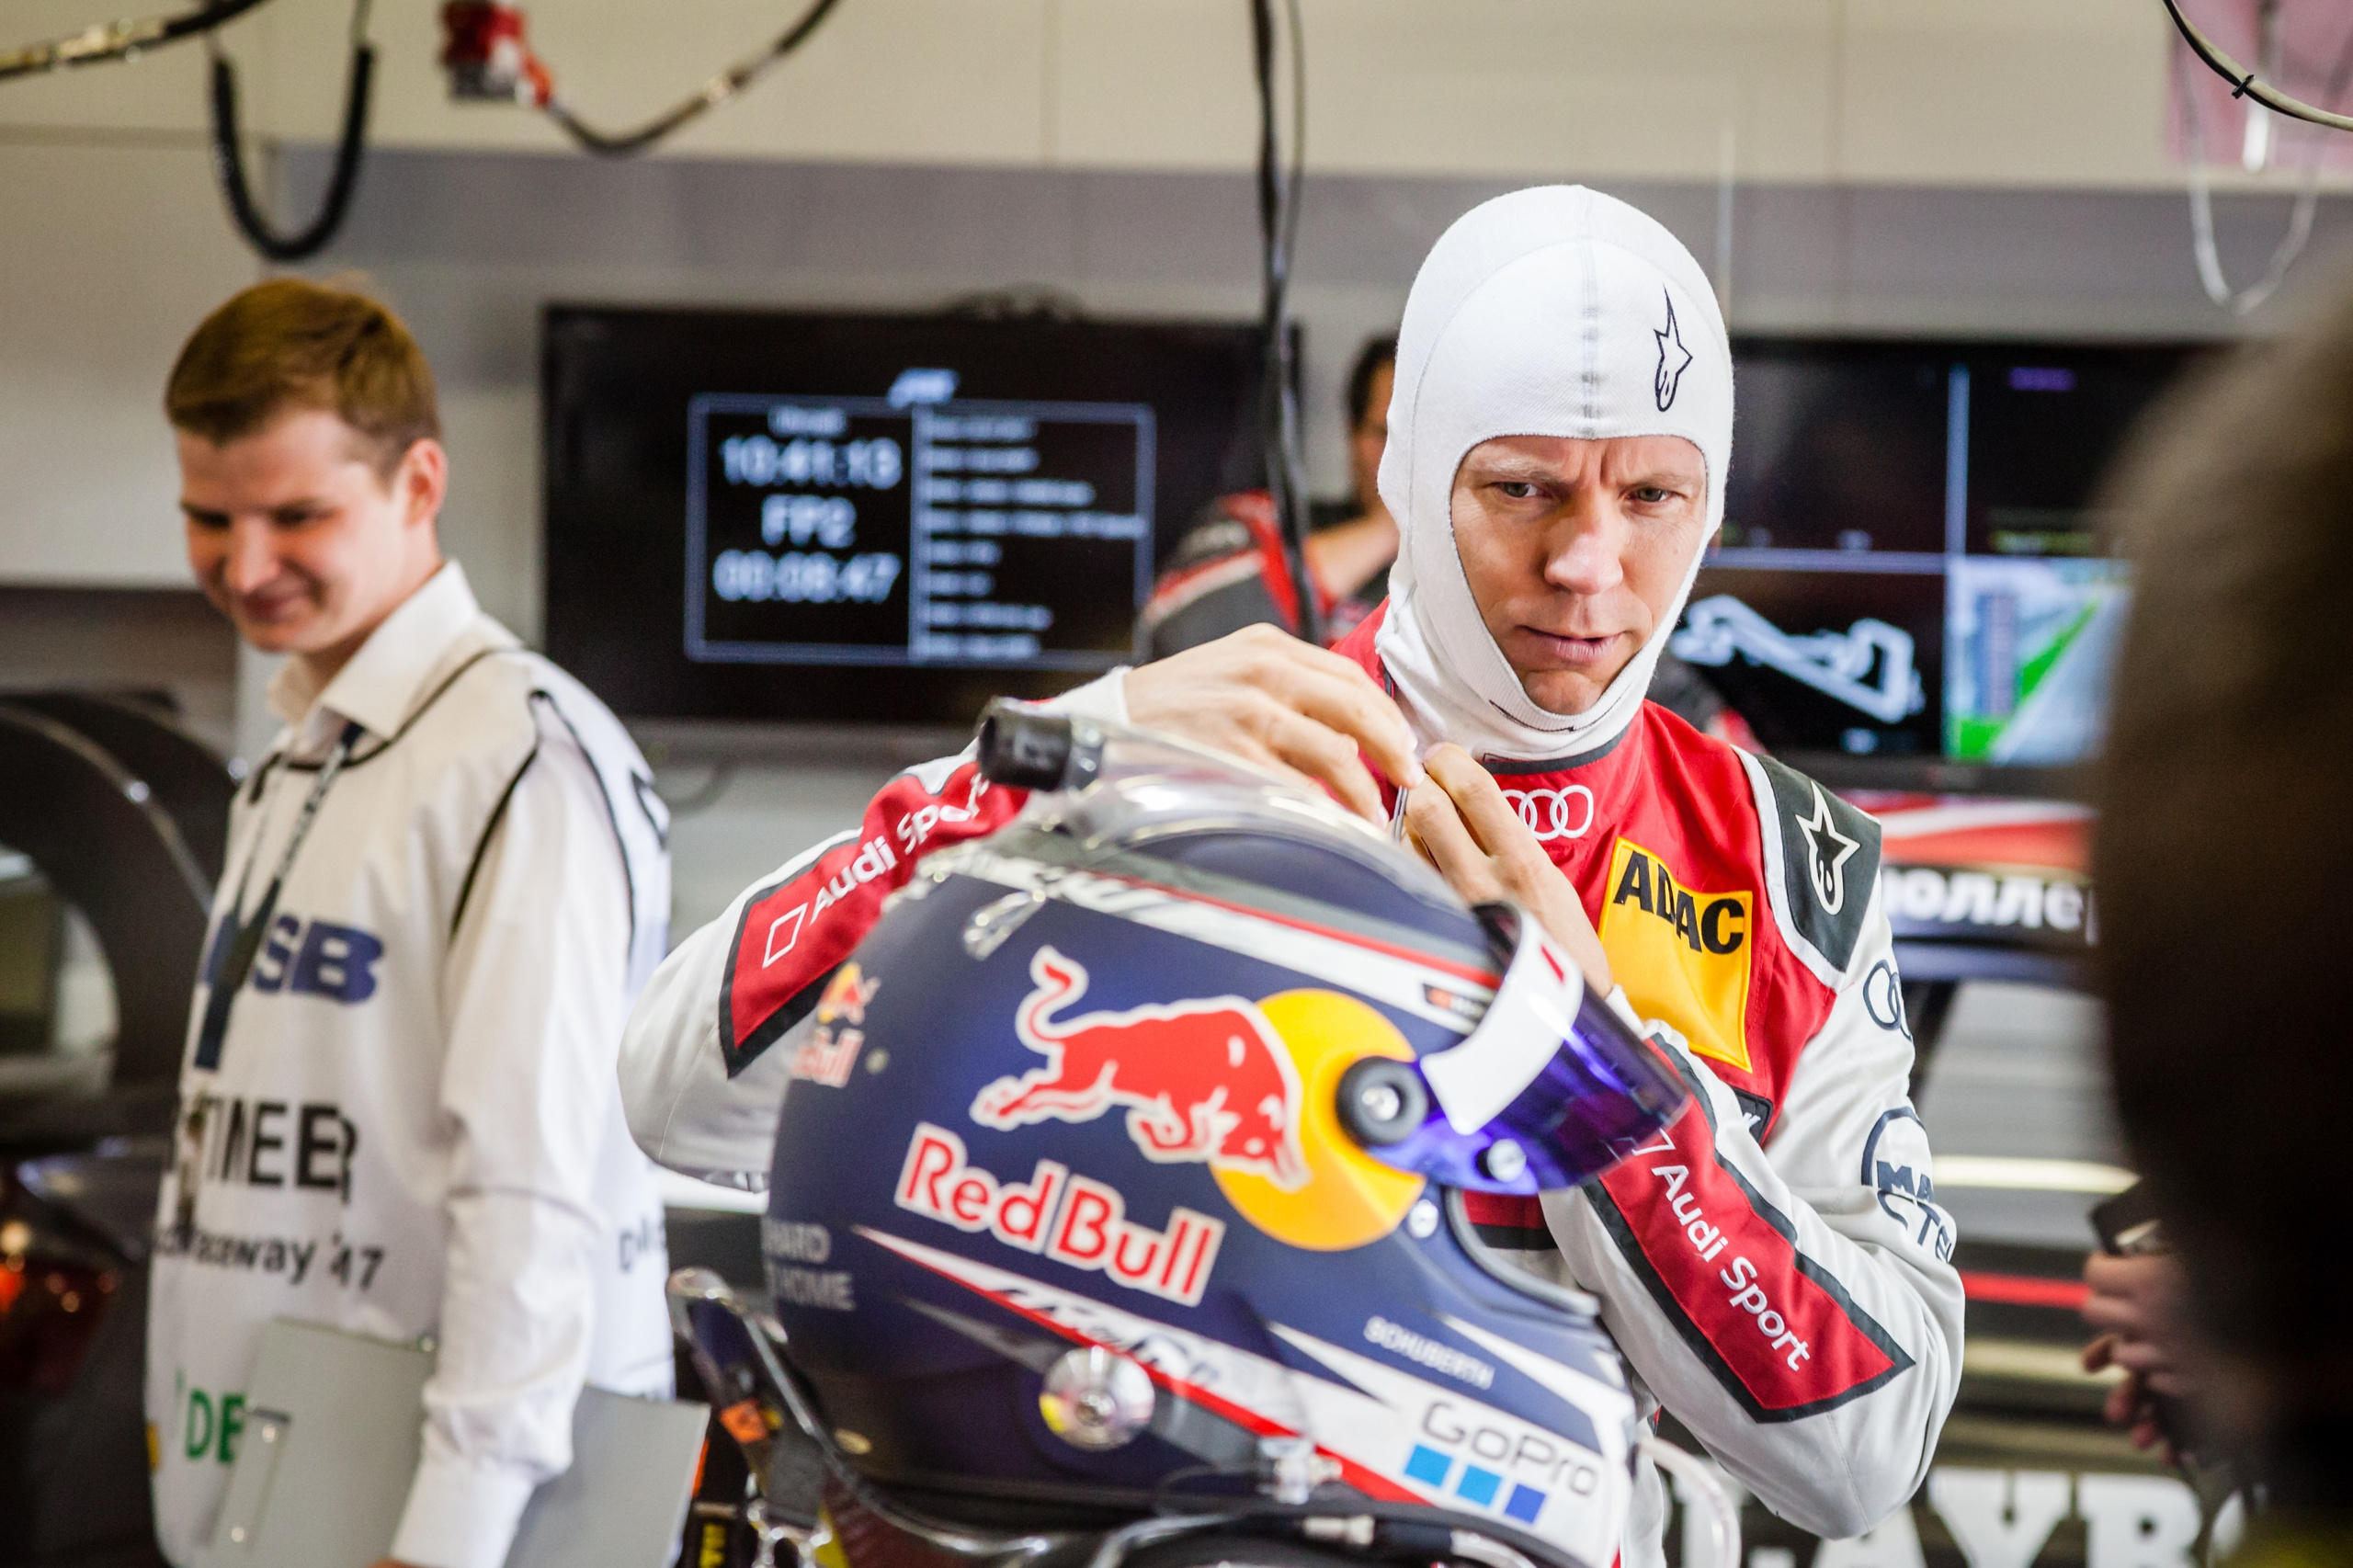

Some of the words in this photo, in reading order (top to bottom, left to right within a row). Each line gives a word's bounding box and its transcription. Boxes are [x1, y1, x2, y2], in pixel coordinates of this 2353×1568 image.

[761, 494, 857, 549] FP2
[809, 835, 898, 926] Audi
[1614, 849, 1745, 955] ADAC
[1652, 1165, 1728, 1262] Audi
[1720, 1256, 1810, 1371] Sport
[1423, 1400, 1599, 1498] GoPro
